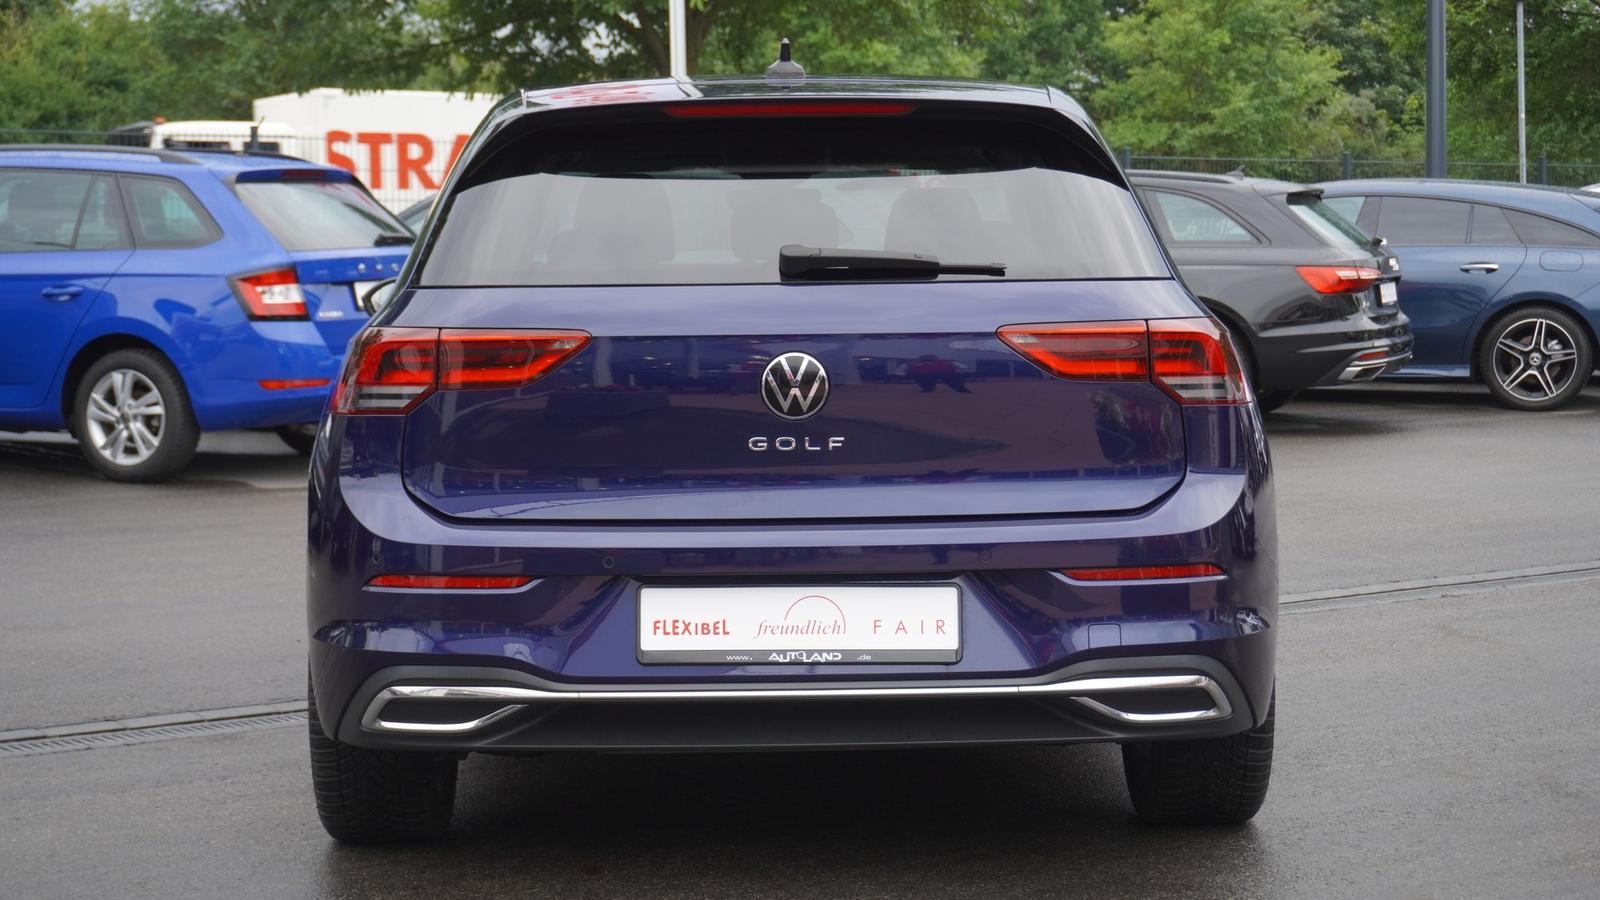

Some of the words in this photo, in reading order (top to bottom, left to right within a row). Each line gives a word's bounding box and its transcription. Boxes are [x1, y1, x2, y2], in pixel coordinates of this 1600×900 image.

[762, 352, 829, 420] VW
[748, 436, 845, 451] GOLF
[653, 619, 730, 636] FLEXIBEL
[753, 619, 842, 640] freundlich
[873, 619, 947, 636] FAIR
[726, 653, 753, 662] www.
[768, 650, 842, 663] AUTOLAND
[857, 652, 872, 662] .de
